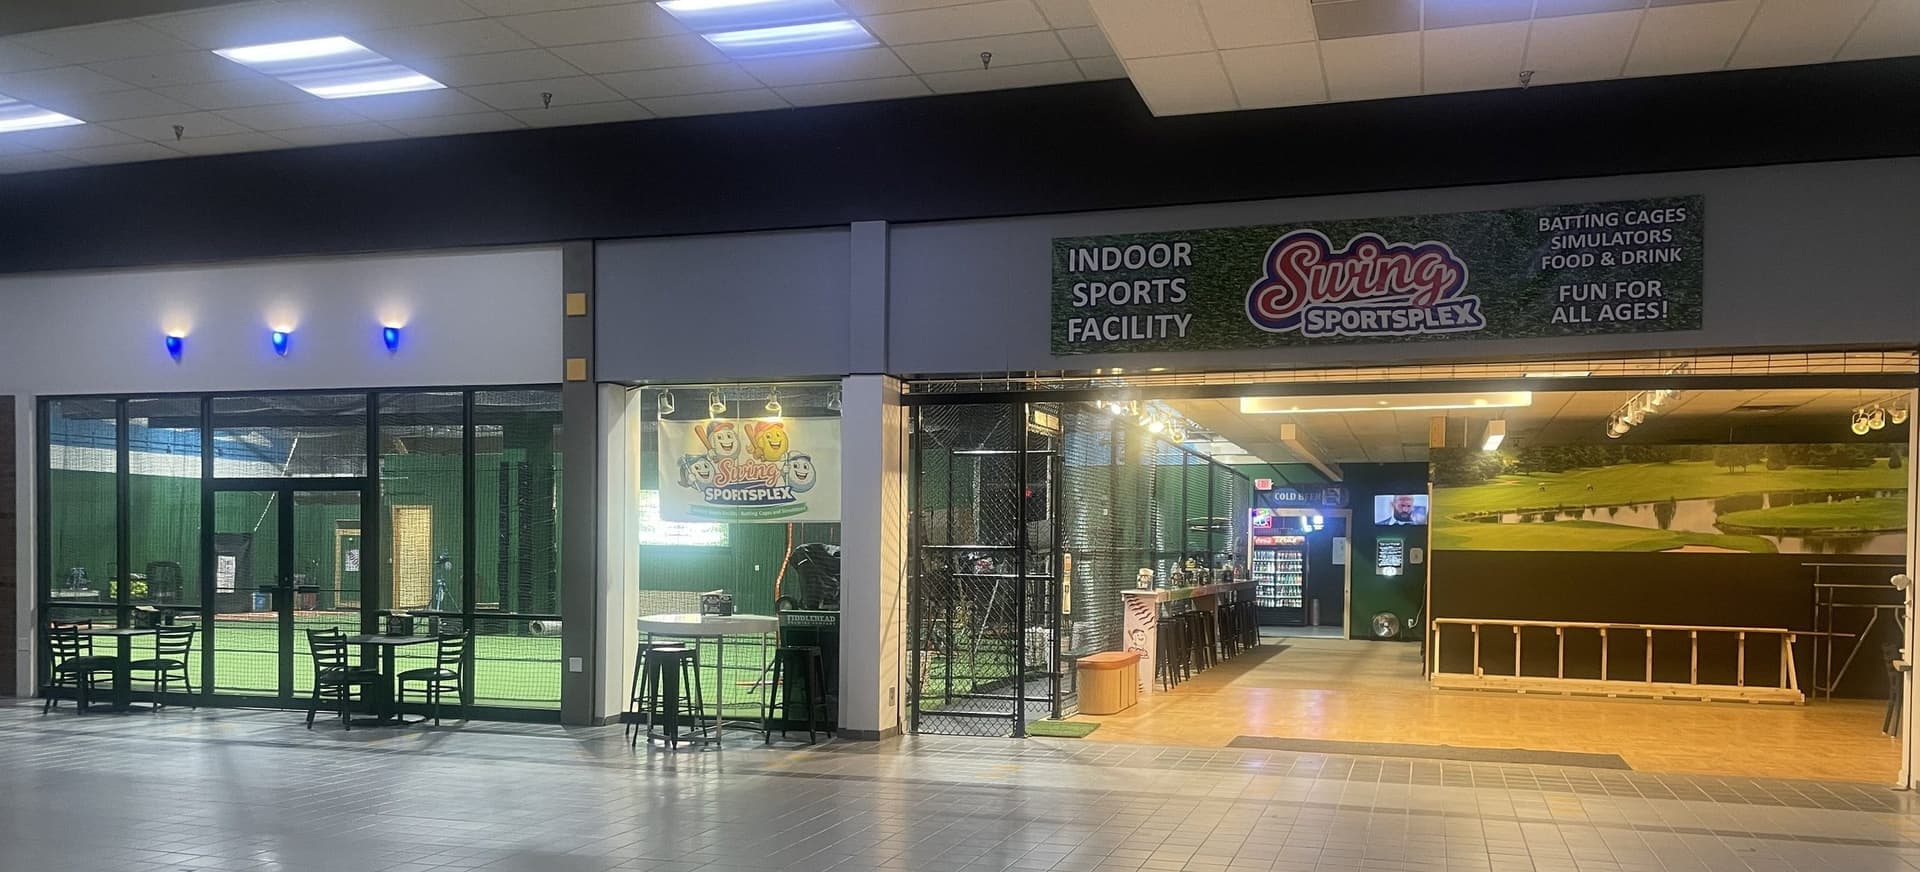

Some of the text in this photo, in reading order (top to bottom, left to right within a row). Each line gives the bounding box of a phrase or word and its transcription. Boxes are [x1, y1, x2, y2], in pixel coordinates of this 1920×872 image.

[1539, 208, 1686, 232] BATTING CAGES
[1551, 228, 1672, 250] SIMULATORS
[1069, 242, 1192, 272] INDOOR
[1542, 248, 1682, 270] FOOD & DRINK
[1257, 240, 1457, 318] Swing
[1559, 280, 1662, 302] FUN FOR
[1072, 278, 1187, 307] SPORTS
[1307, 303, 1477, 331] SPORTSPLEX
[1551, 301, 1668, 324] ALL AGES!
[1068, 313, 1192, 342] FACILITY
[713, 457, 780, 488] Swing
[705, 486, 793, 501] SPORTSPLEX
[1274, 491, 1297, 501] COLD
